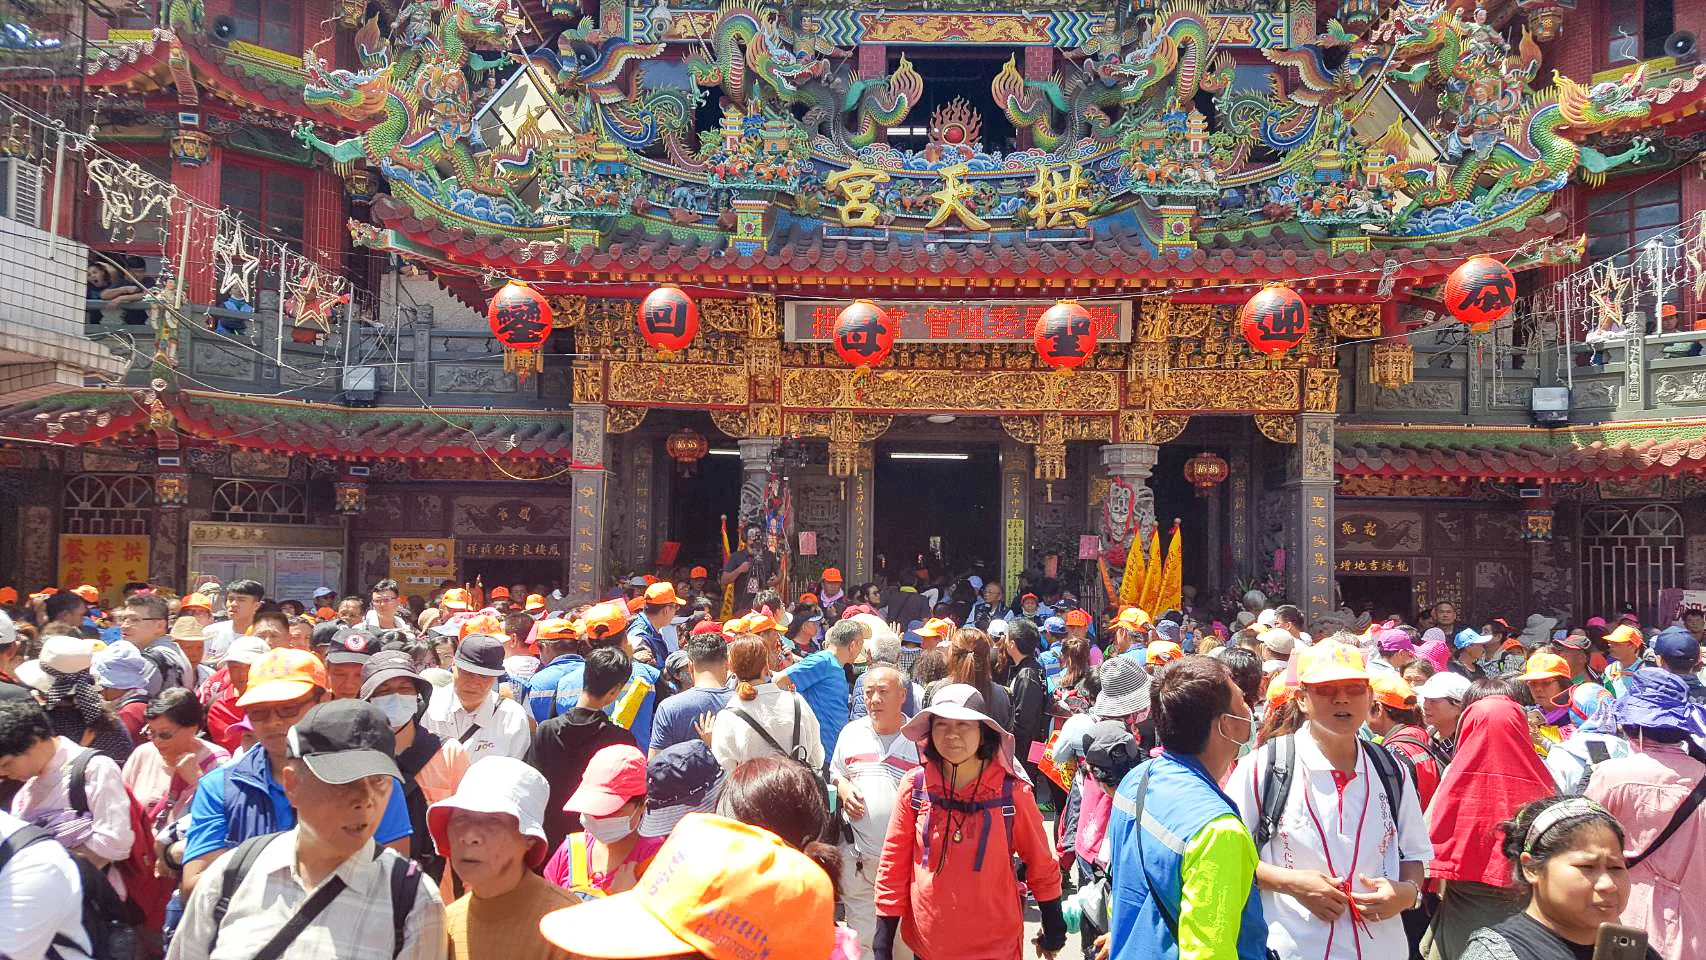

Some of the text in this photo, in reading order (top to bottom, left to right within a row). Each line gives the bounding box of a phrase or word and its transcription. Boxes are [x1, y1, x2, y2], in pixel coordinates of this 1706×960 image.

[826, 162, 1093, 231] 拱天宮
[645, 300, 689, 337] 回
[838, 310, 887, 356] 母
[1045, 308, 1090, 356] 聖
[1256, 299, 1304, 341] 迎
